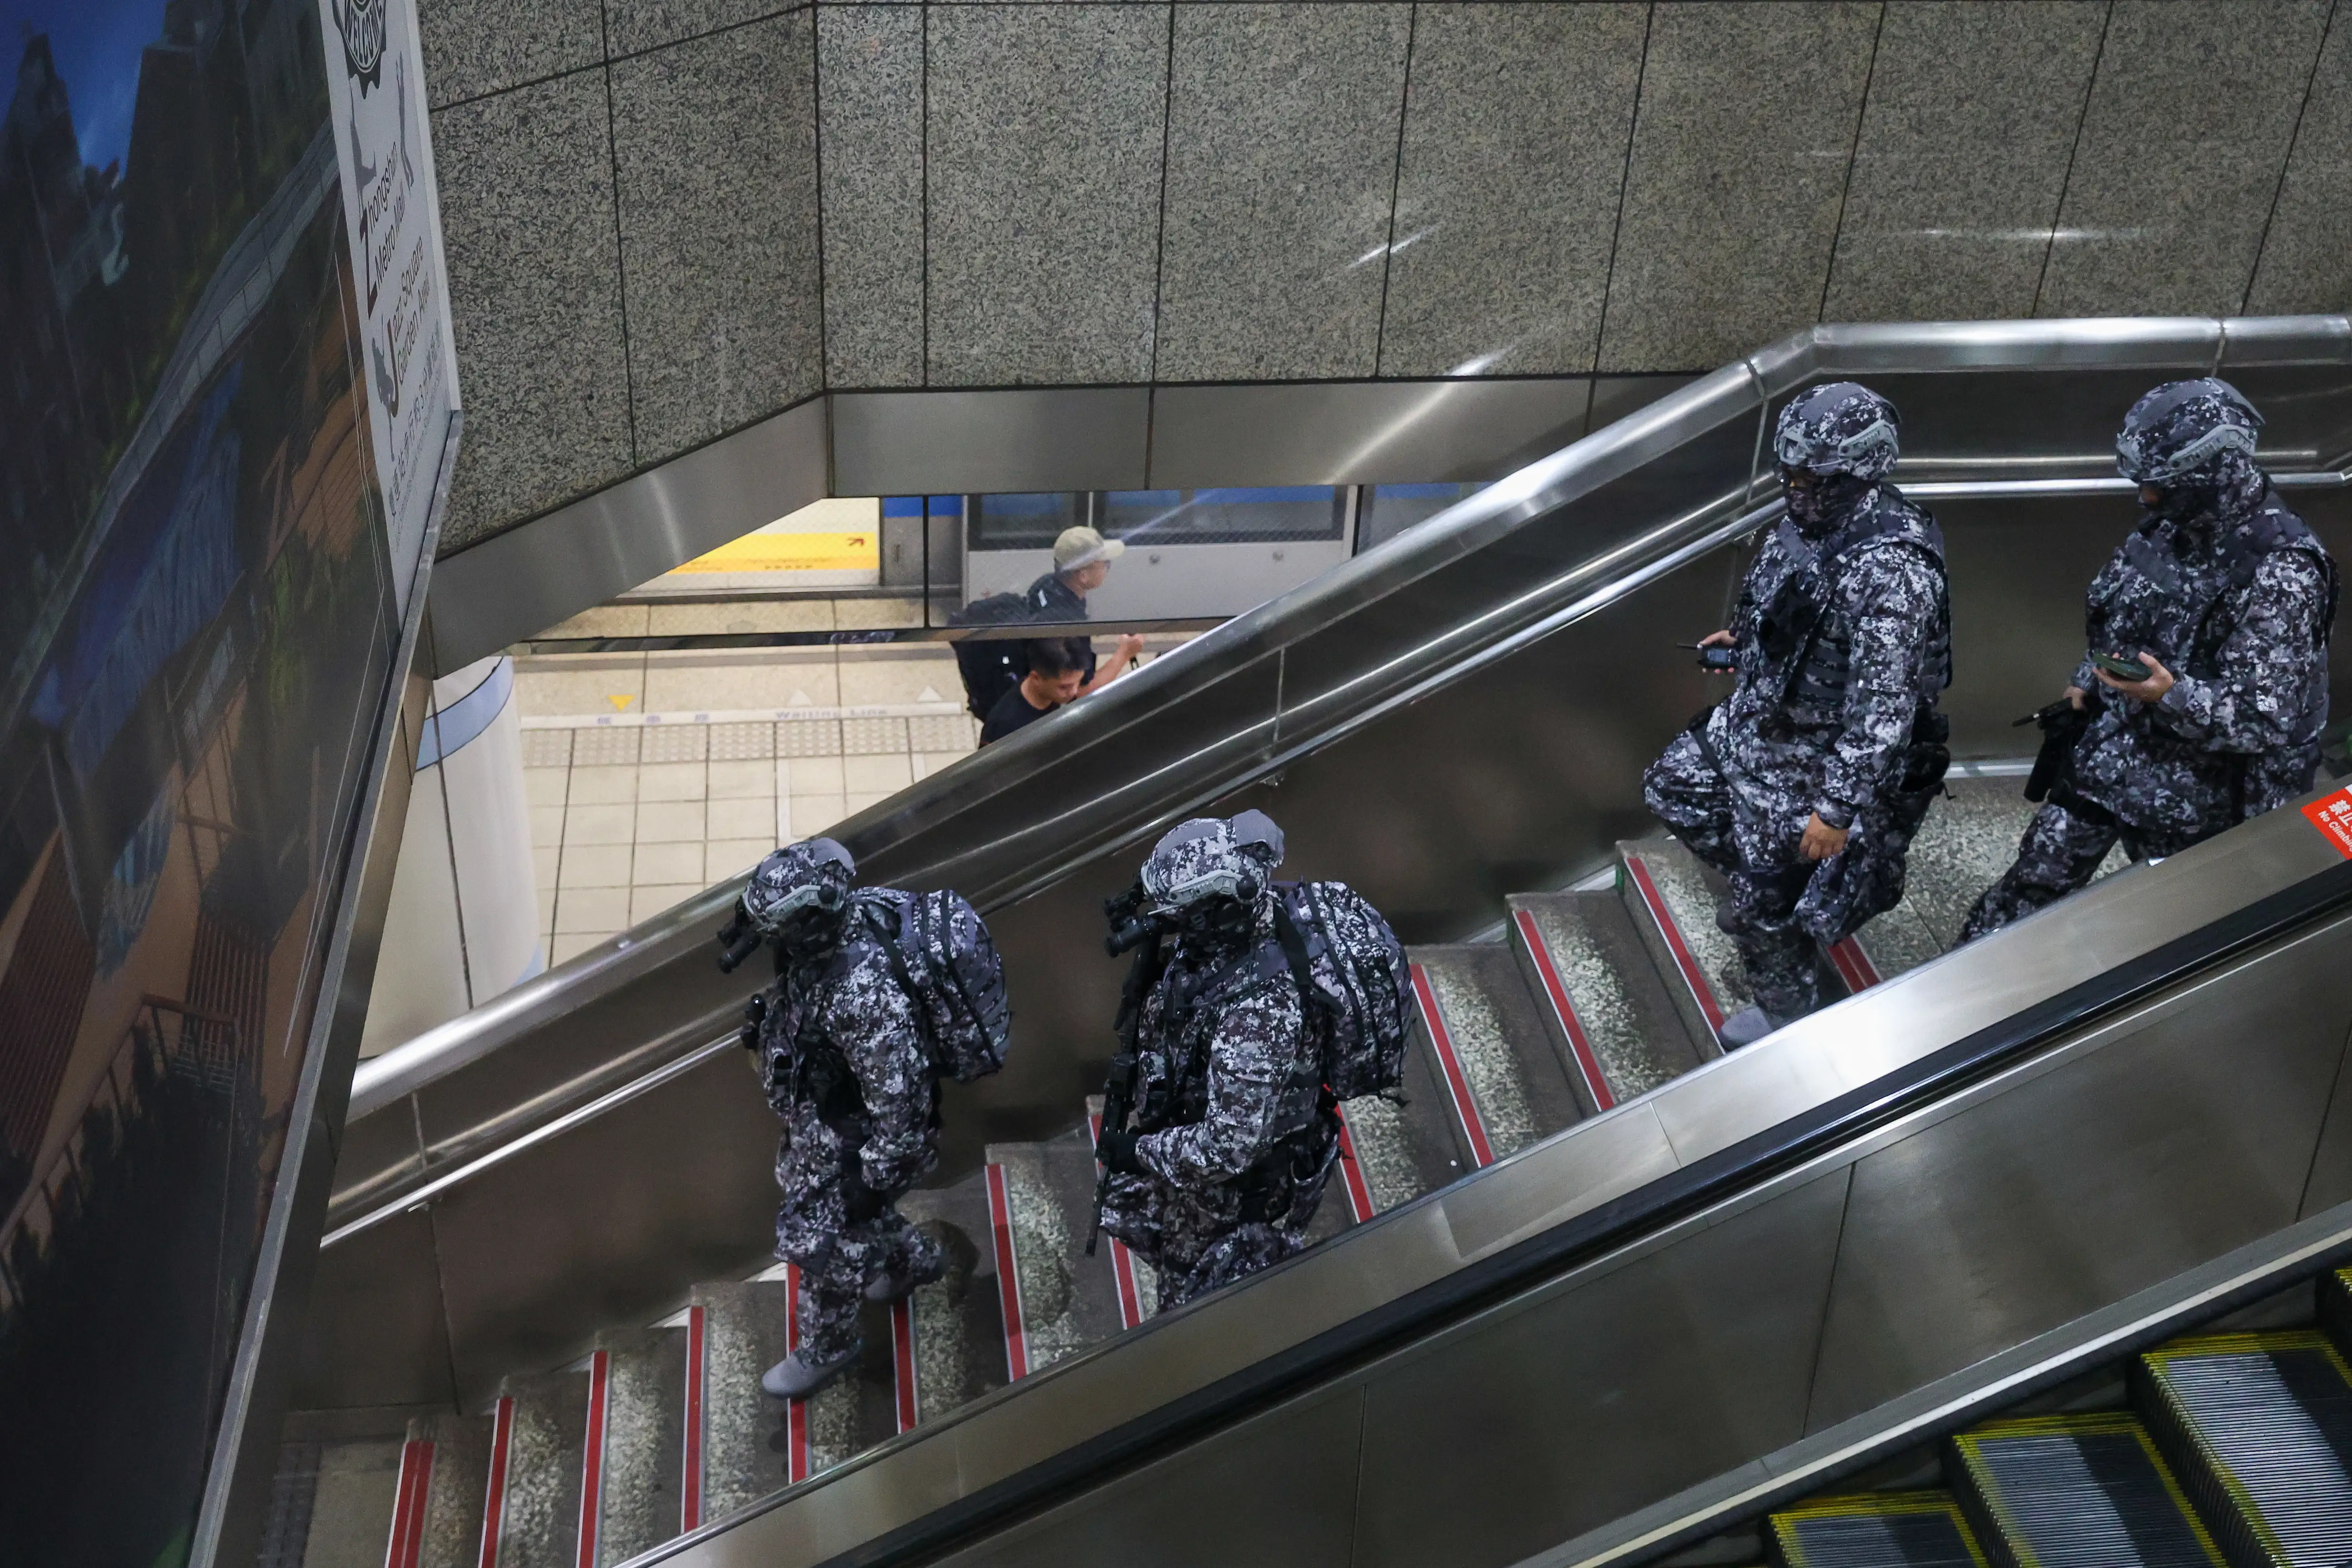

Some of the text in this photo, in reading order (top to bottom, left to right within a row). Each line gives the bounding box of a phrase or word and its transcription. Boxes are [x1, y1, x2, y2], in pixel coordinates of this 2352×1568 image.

[359, 142, 397, 320] Zhongshan
[375, 179, 405, 289] Metro Mall
[387, 236, 423, 418] Jazz Square
[397, 271, 430, 385] Garden Area
[776, 711, 840, 721] Waiting
[2318, 810, 2330, 822] No
[2328, 800, 2352, 832] 禁止
